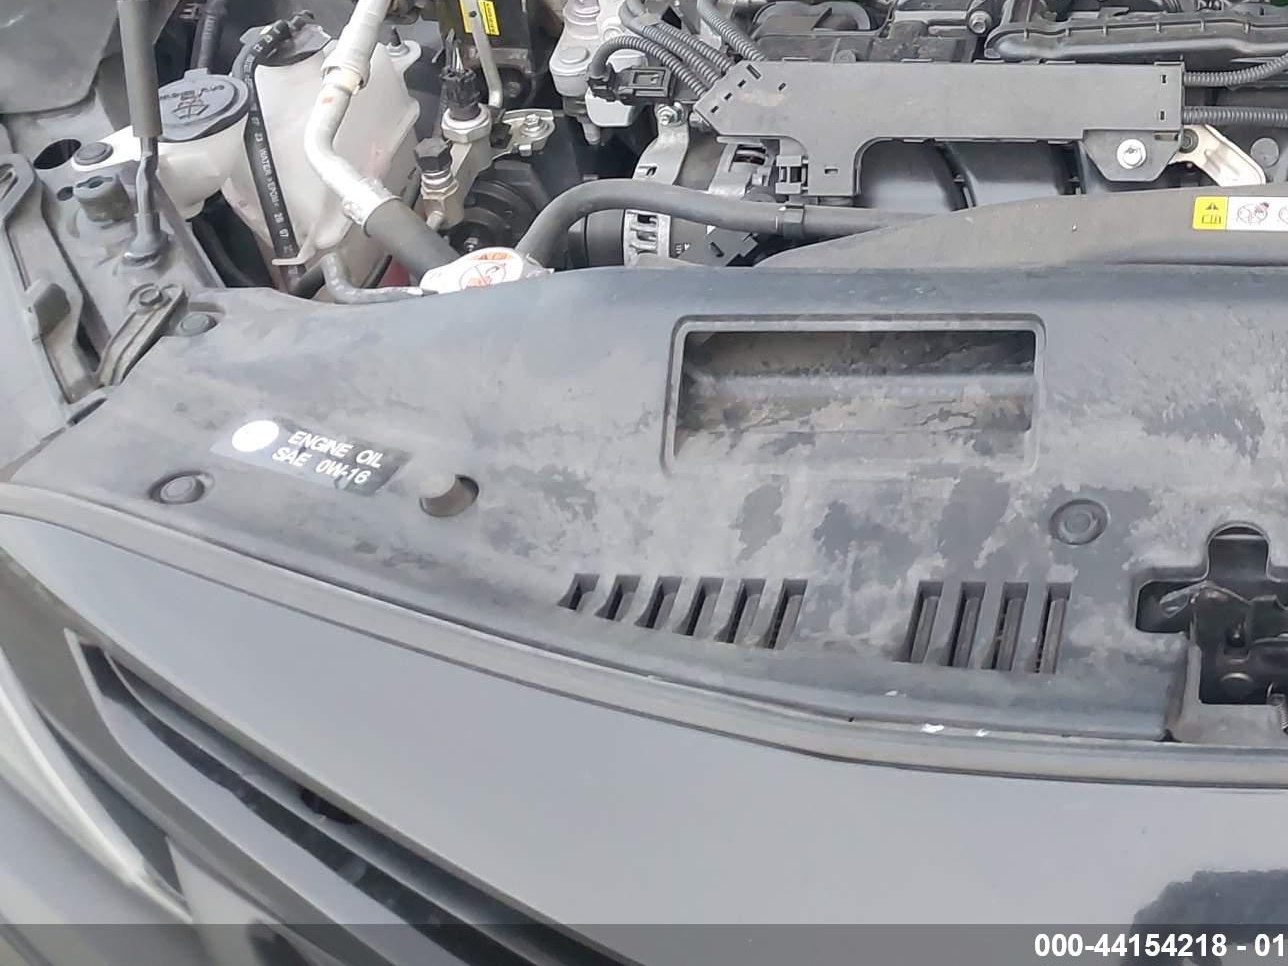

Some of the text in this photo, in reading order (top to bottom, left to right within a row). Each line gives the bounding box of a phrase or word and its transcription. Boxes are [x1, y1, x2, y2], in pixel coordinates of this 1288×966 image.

[259, 147, 273, 175] WATER
[272, 447, 372, 484] SAE 0W-16
[288, 431, 384, 469] ENGINE OIL
